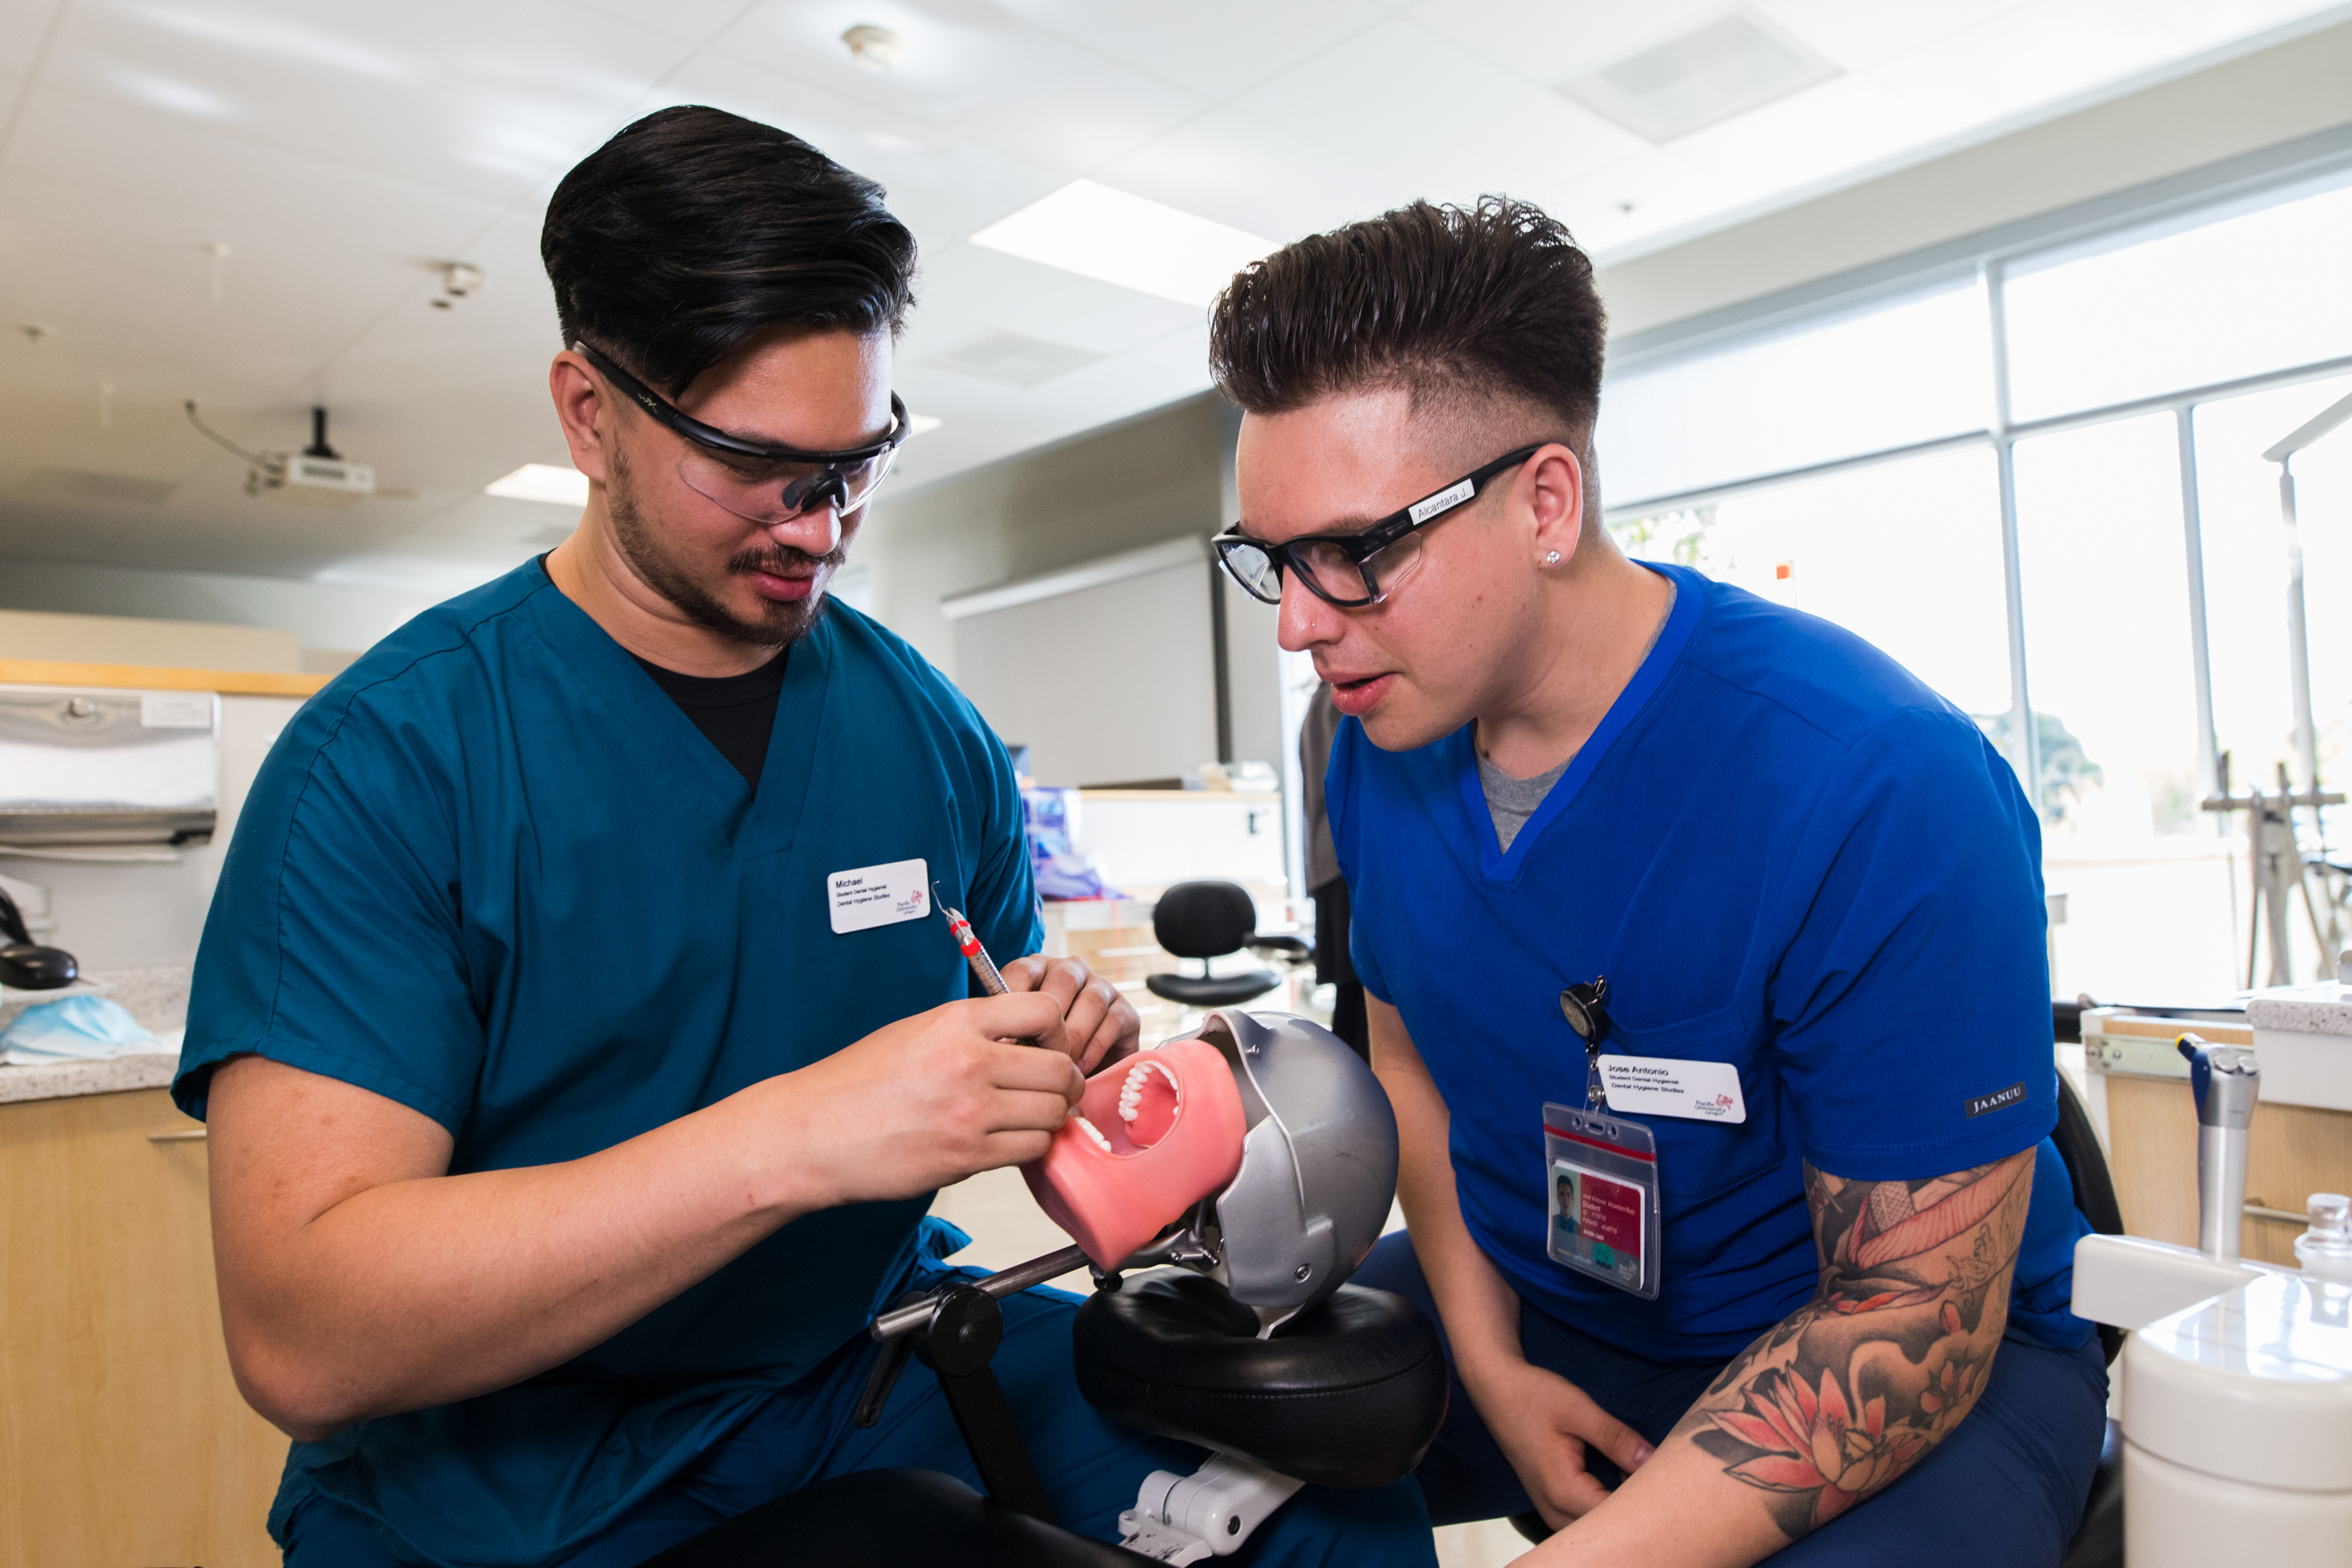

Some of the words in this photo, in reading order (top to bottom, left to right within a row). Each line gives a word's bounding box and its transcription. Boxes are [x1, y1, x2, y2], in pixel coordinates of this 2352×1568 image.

[1418, 494, 1458, 519] Alcantara
[1460, 487, 1468, 498] J.
[836, 877, 863, 889] Michael
[837, 890, 853, 898] Student
[868, 884, 887, 893] Hygienist
[853, 896, 872, 904] Hygiene
[873, 893, 890, 901] Studies
[896, 904, 918, 912] University
[1607, 1064, 1629, 1074] Jose
[1631, 1066, 1670, 1076] Antonio
[1660, 1086, 1685, 1094] Studies
[1973, 1085, 2021, 1115] JAANUU
